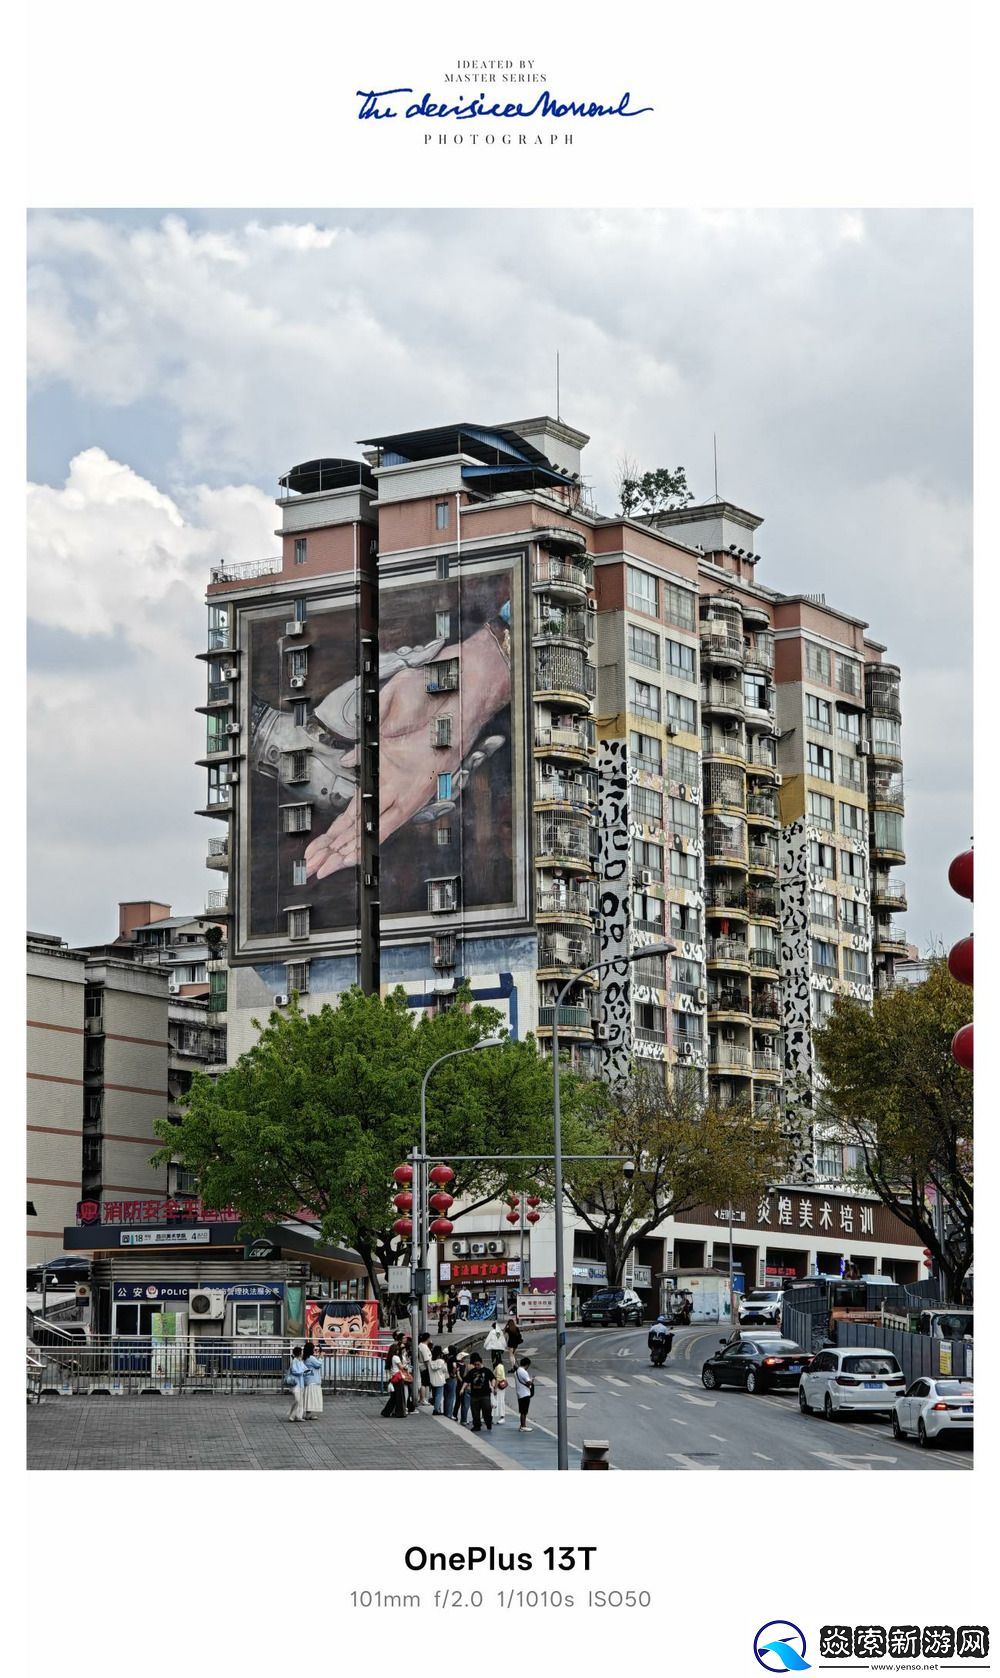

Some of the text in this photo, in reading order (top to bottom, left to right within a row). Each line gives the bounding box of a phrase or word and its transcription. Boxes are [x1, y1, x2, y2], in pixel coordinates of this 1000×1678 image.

[757, 1195, 874, 1235] 炎煌美术培训
[135, 1234, 143, 1242] 18
[117, 1287, 188, 1297] 公安 POLIC
